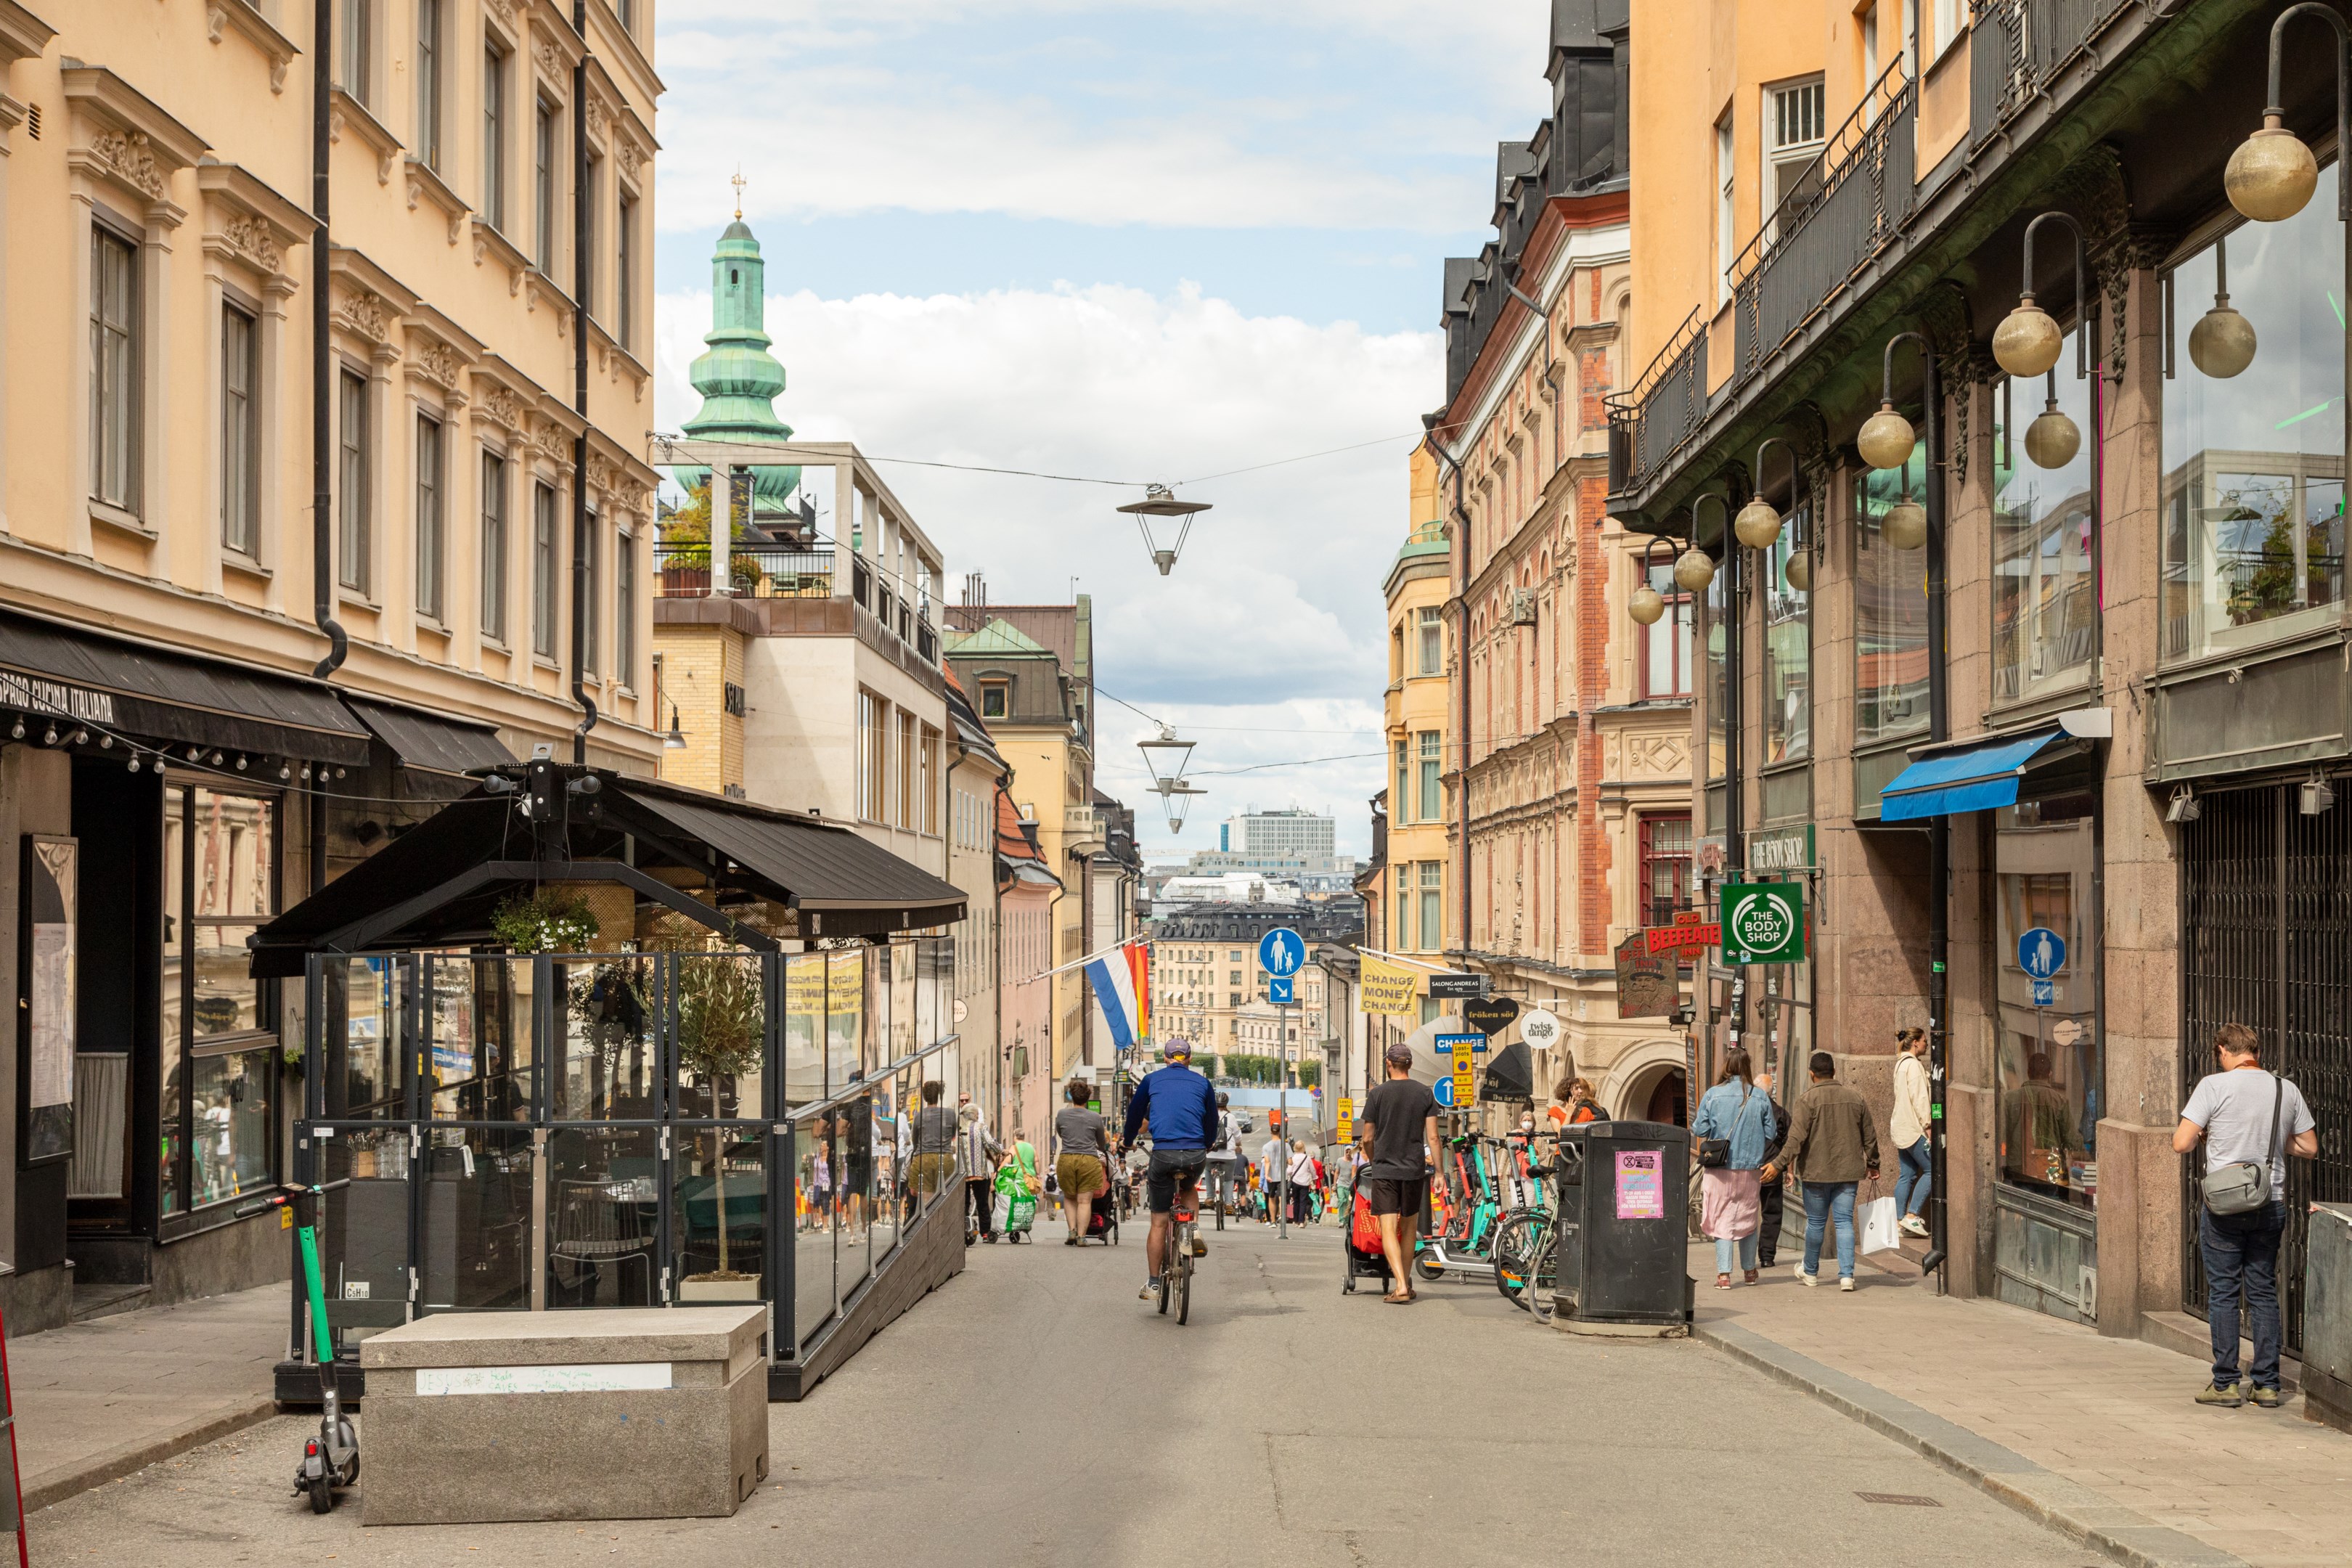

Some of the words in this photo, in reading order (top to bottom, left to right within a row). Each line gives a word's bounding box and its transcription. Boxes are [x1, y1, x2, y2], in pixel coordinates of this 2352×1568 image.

[32, 679, 68, 715] CUCINA
[70, 687, 114, 724] ITALIANA
[1752, 841, 1766, 869] THE
[1766, 839, 1784, 868] BODY
[1784, 836, 1802, 867] SHOP
[1677, 913, 1699, 925] OLD
[1752, 911, 1773, 920] THE
[1744, 920, 1782, 932] BODY
[1648, 924, 1722, 953] BEEFEATE
[1747, 931, 1781, 942] SHOP
[1681, 947, 1701, 957] INN
[1365, 974, 1413, 986] CHANGE
[1365, 987, 1413, 1000] MONEY
[2025, 979, 2063, 1000] Receptionen
[1363, 1000, 1412, 1011] CHANGE
[1530, 1021, 1551, 1030] twist
[1528, 1028, 1553, 1039] tango
[347, 1288, 368, 1297] C5H10
[417, 1371, 462, 1391] JESUS
